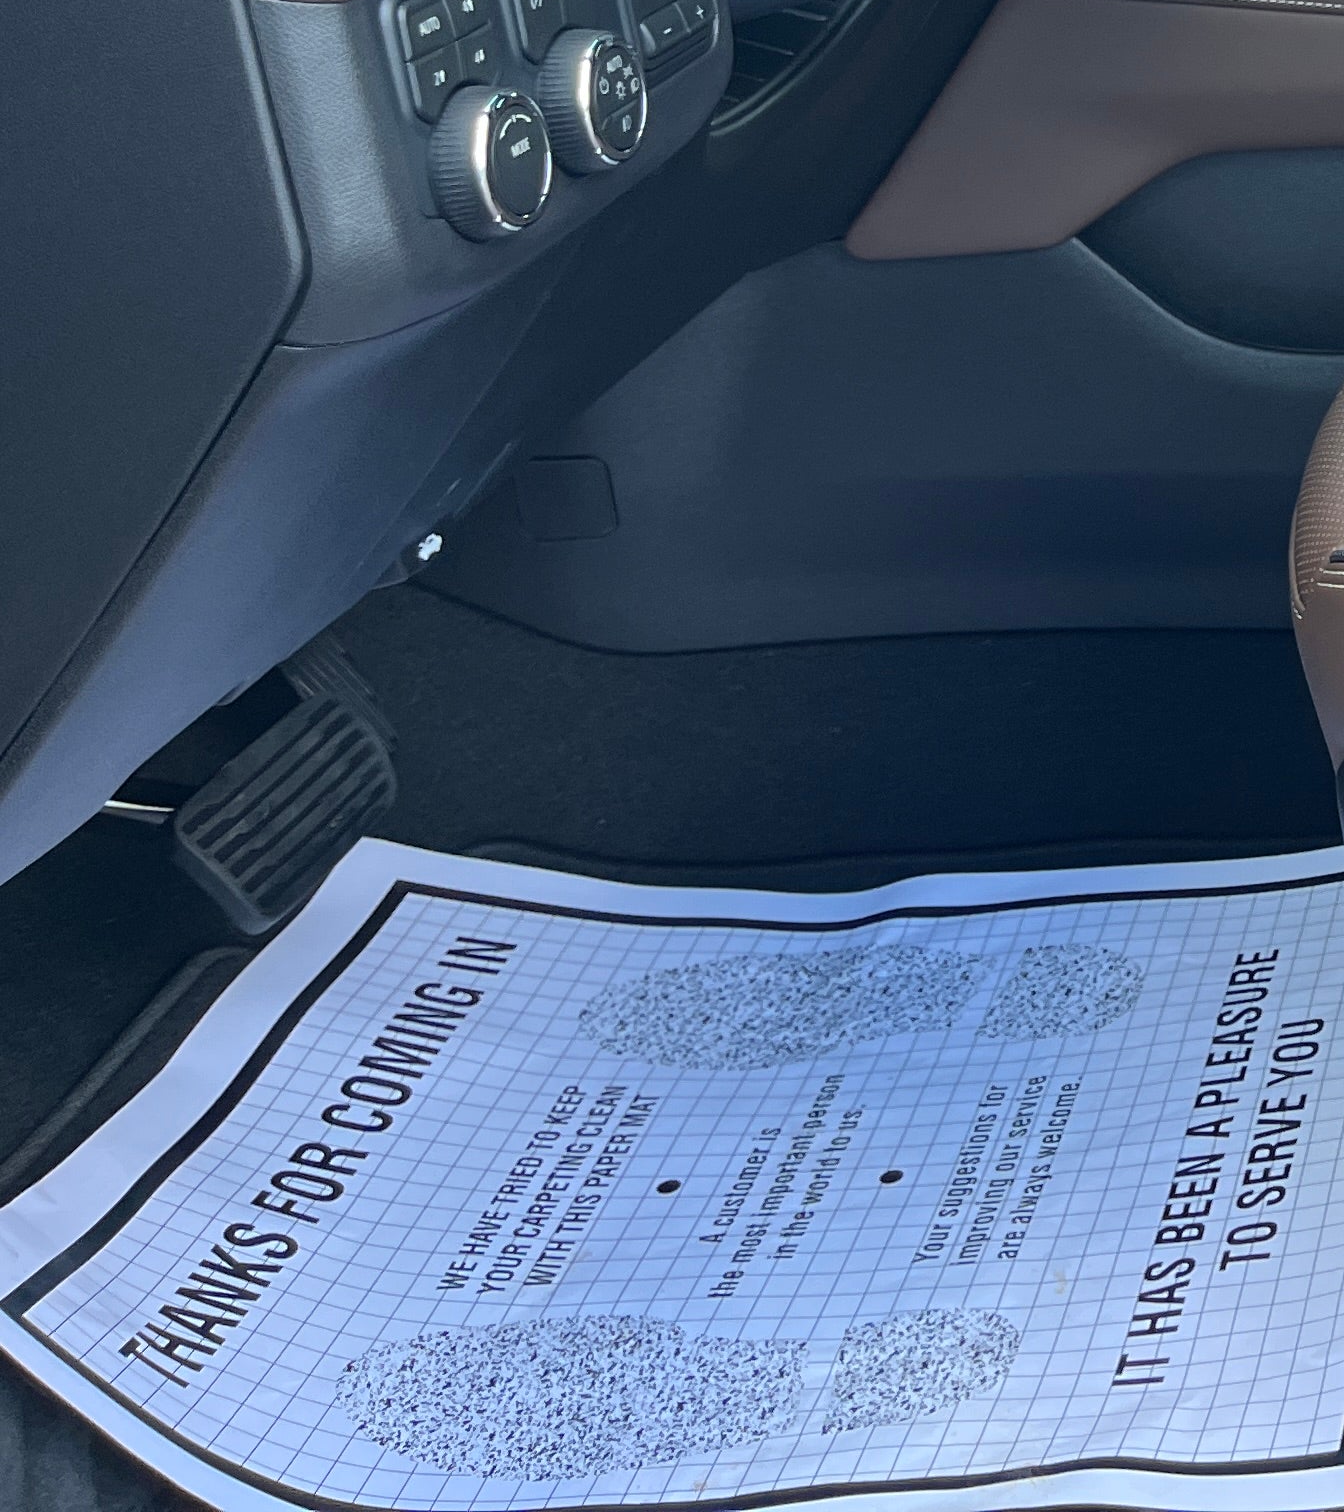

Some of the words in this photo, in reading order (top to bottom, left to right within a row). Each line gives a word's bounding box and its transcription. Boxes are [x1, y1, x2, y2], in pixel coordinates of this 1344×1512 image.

[1194, 947, 1280, 1110] PLEASURE
[1266, 1017, 1325, 1088] YOU
[823, 1135, 851, 1153] to
[838, 1103, 867, 1132] us.
[1037, 1076, 1083, 1161] welcome.
[1186, 1115, 1235, 1139] A
[1236, 1091, 1308, 1207] SERVE
[118, 1222, 299, 1388] THANKS
[250, 1142, 370, 1225] FOR
[321, 981, 486, 1134] COMING
[437, 936, 518, 976] IN
[436, 1261, 478, 1291] WE
[459, 1210, 510, 1255] HAVE
[491, 1157, 544, 1206] TRIED
[526, 1130, 561, 1151] TO
[544, 1085, 587, 1125] KEEP
[476, 1243, 532, 1295] YOUR
[513, 1142, 593, 1239] CARPETING
[575, 1086, 627, 1138] CLEAN
[523, 1240, 576, 1286] WITH
[555, 1194, 602, 1234] THIS
[583, 1133, 638, 1188] PAPER
[619, 1094, 660, 1128] MAT
[699, 1232, 726, 1244] A
[713, 1146, 770, 1227] customer
[752, 1126, 781, 1142] is
[708, 1269, 744, 1299] the
[731, 1219, 771, 1263] most
[751, 1131, 816, 1217] important
[803, 1073, 845, 1131] person
[802, 1157, 841, 1207] world
[911, 1223, 952, 1265] Your
[939, 1113, 997, 1218] suggestions
[978, 1084, 1009, 1108] for
[951, 1177, 1015, 1266] improving
[995, 1143, 1022, 1172] our
[1009, 1075, 1047, 1138] service
[1009, 1164, 1052, 1225] always
[1155, 1152, 1226, 1246] BEEN
[767, 1244, 798, 1260] in
[779, 1210, 814, 1238] the
[997, 1230, 1026, 1260] are
[1219, 1220, 1279, 1271] TO
[1127, 1256, 1196, 1338] HAS
[1111, 1353, 1171, 1387] IT
